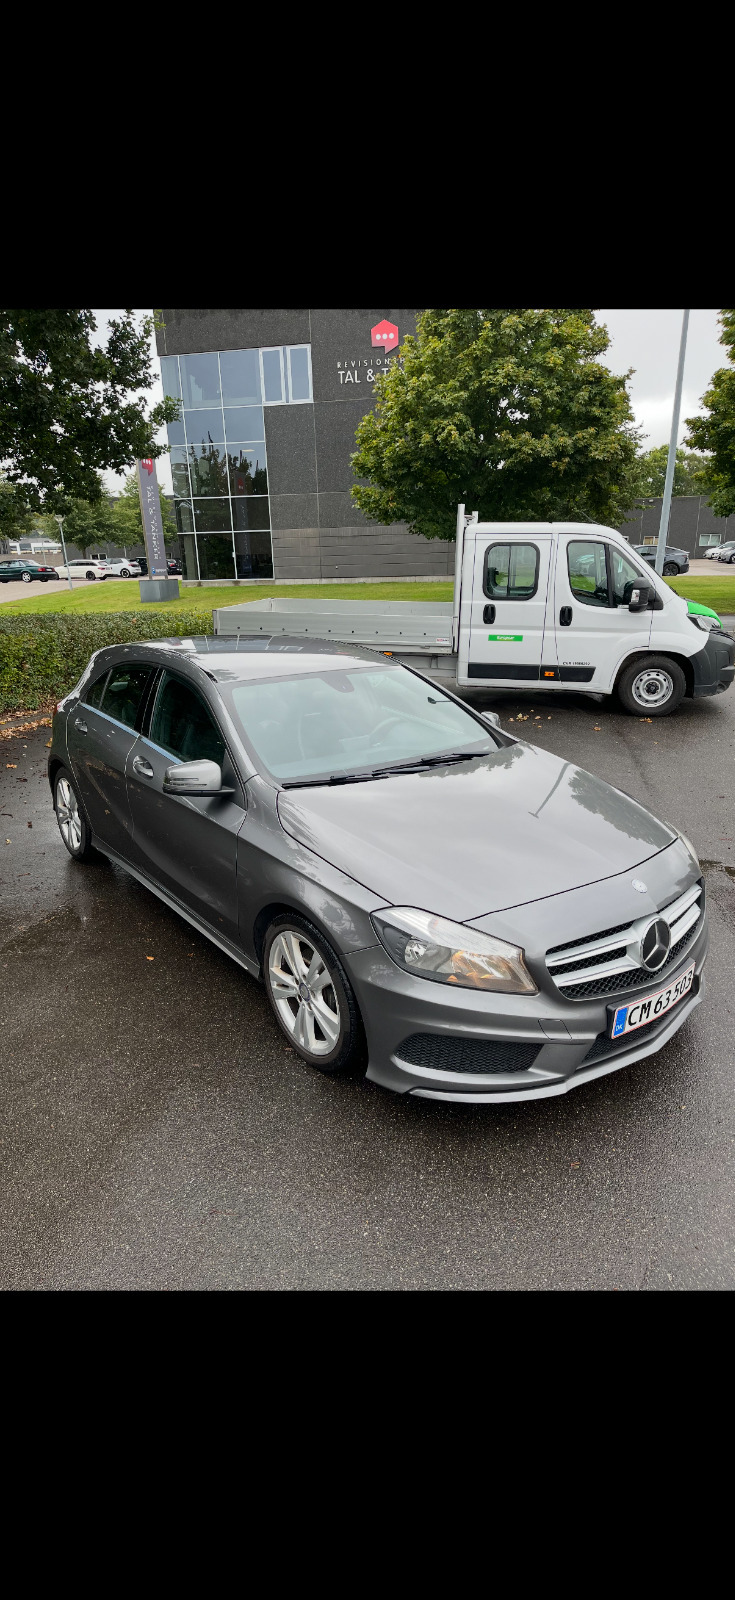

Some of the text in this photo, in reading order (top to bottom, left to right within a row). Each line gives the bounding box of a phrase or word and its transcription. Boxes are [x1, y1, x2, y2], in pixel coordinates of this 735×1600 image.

[337, 370, 361, 384] TAL
[366, 368, 376, 382] &
[628, 969, 693, 1026] CM 63 503
[615, 1023, 623, 1031] DK
